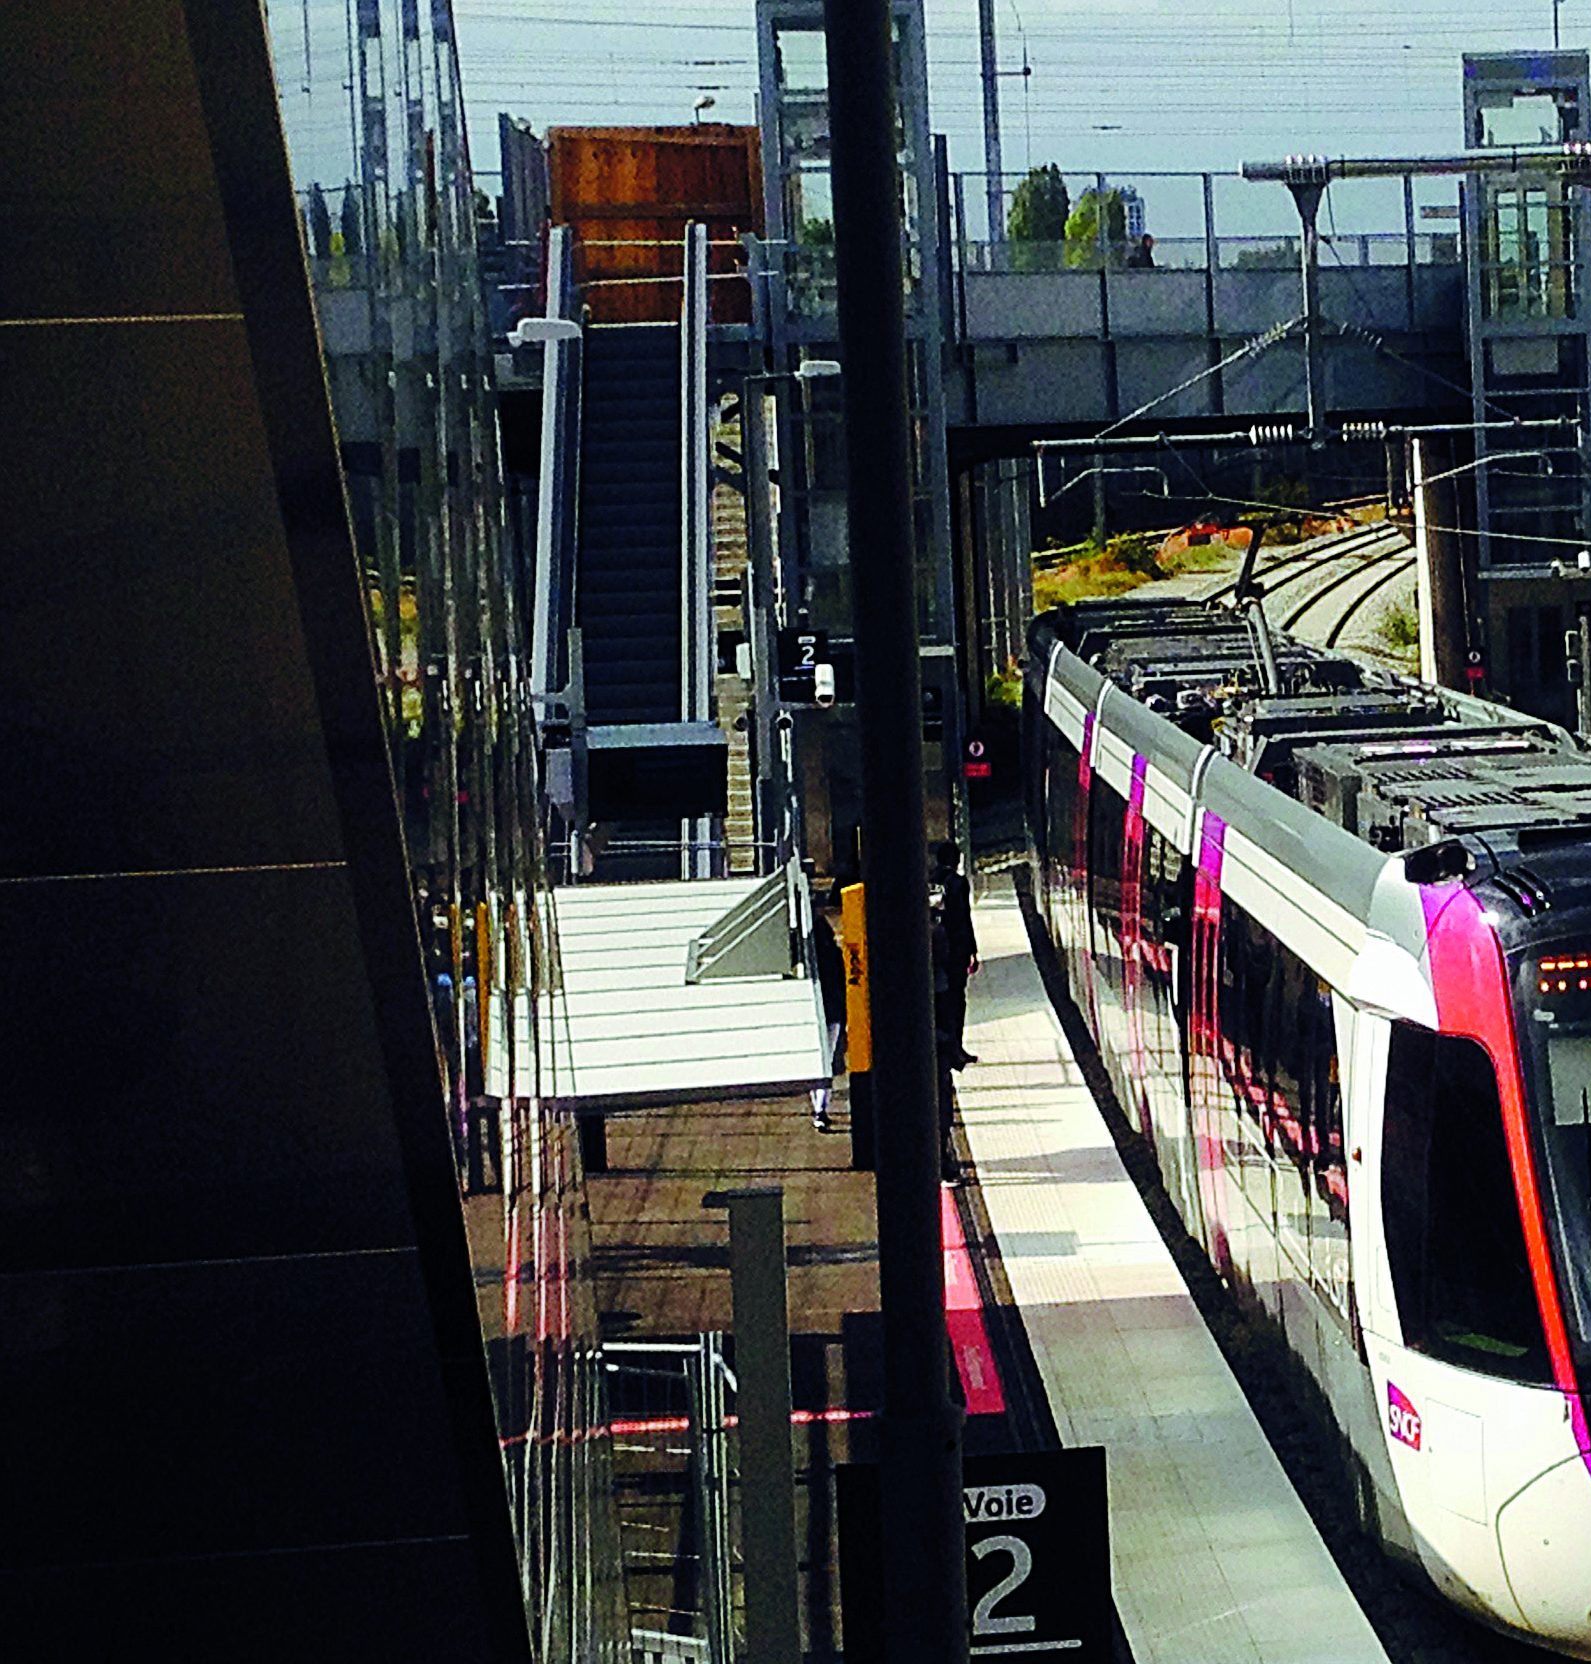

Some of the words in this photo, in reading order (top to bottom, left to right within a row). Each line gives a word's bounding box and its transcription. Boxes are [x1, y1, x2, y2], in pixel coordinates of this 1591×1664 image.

[802, 645, 815, 665] 2
[963, 1488, 1034, 1518] Voie
[971, 1535, 1035, 1635] 2
